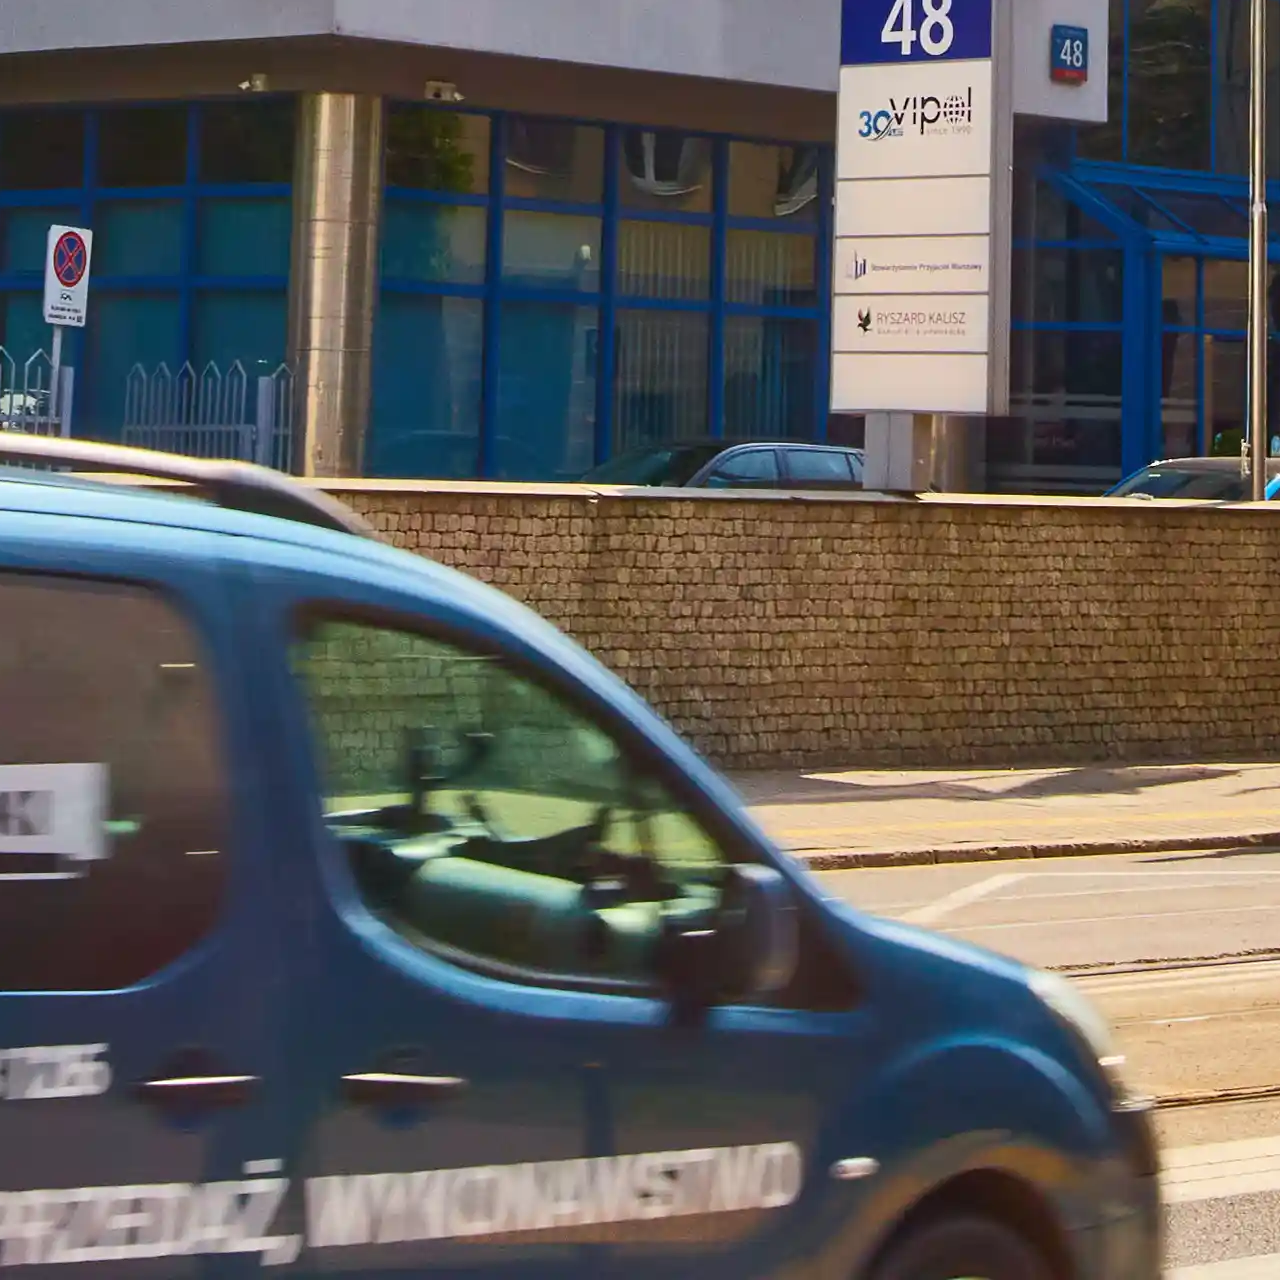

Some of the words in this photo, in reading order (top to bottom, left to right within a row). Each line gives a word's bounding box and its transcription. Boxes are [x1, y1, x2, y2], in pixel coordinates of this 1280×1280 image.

[1060, 39, 1083, 67] 48
[876, 312, 926, 325] RYSZARD
[928, 312, 966, 325] KALISZ
